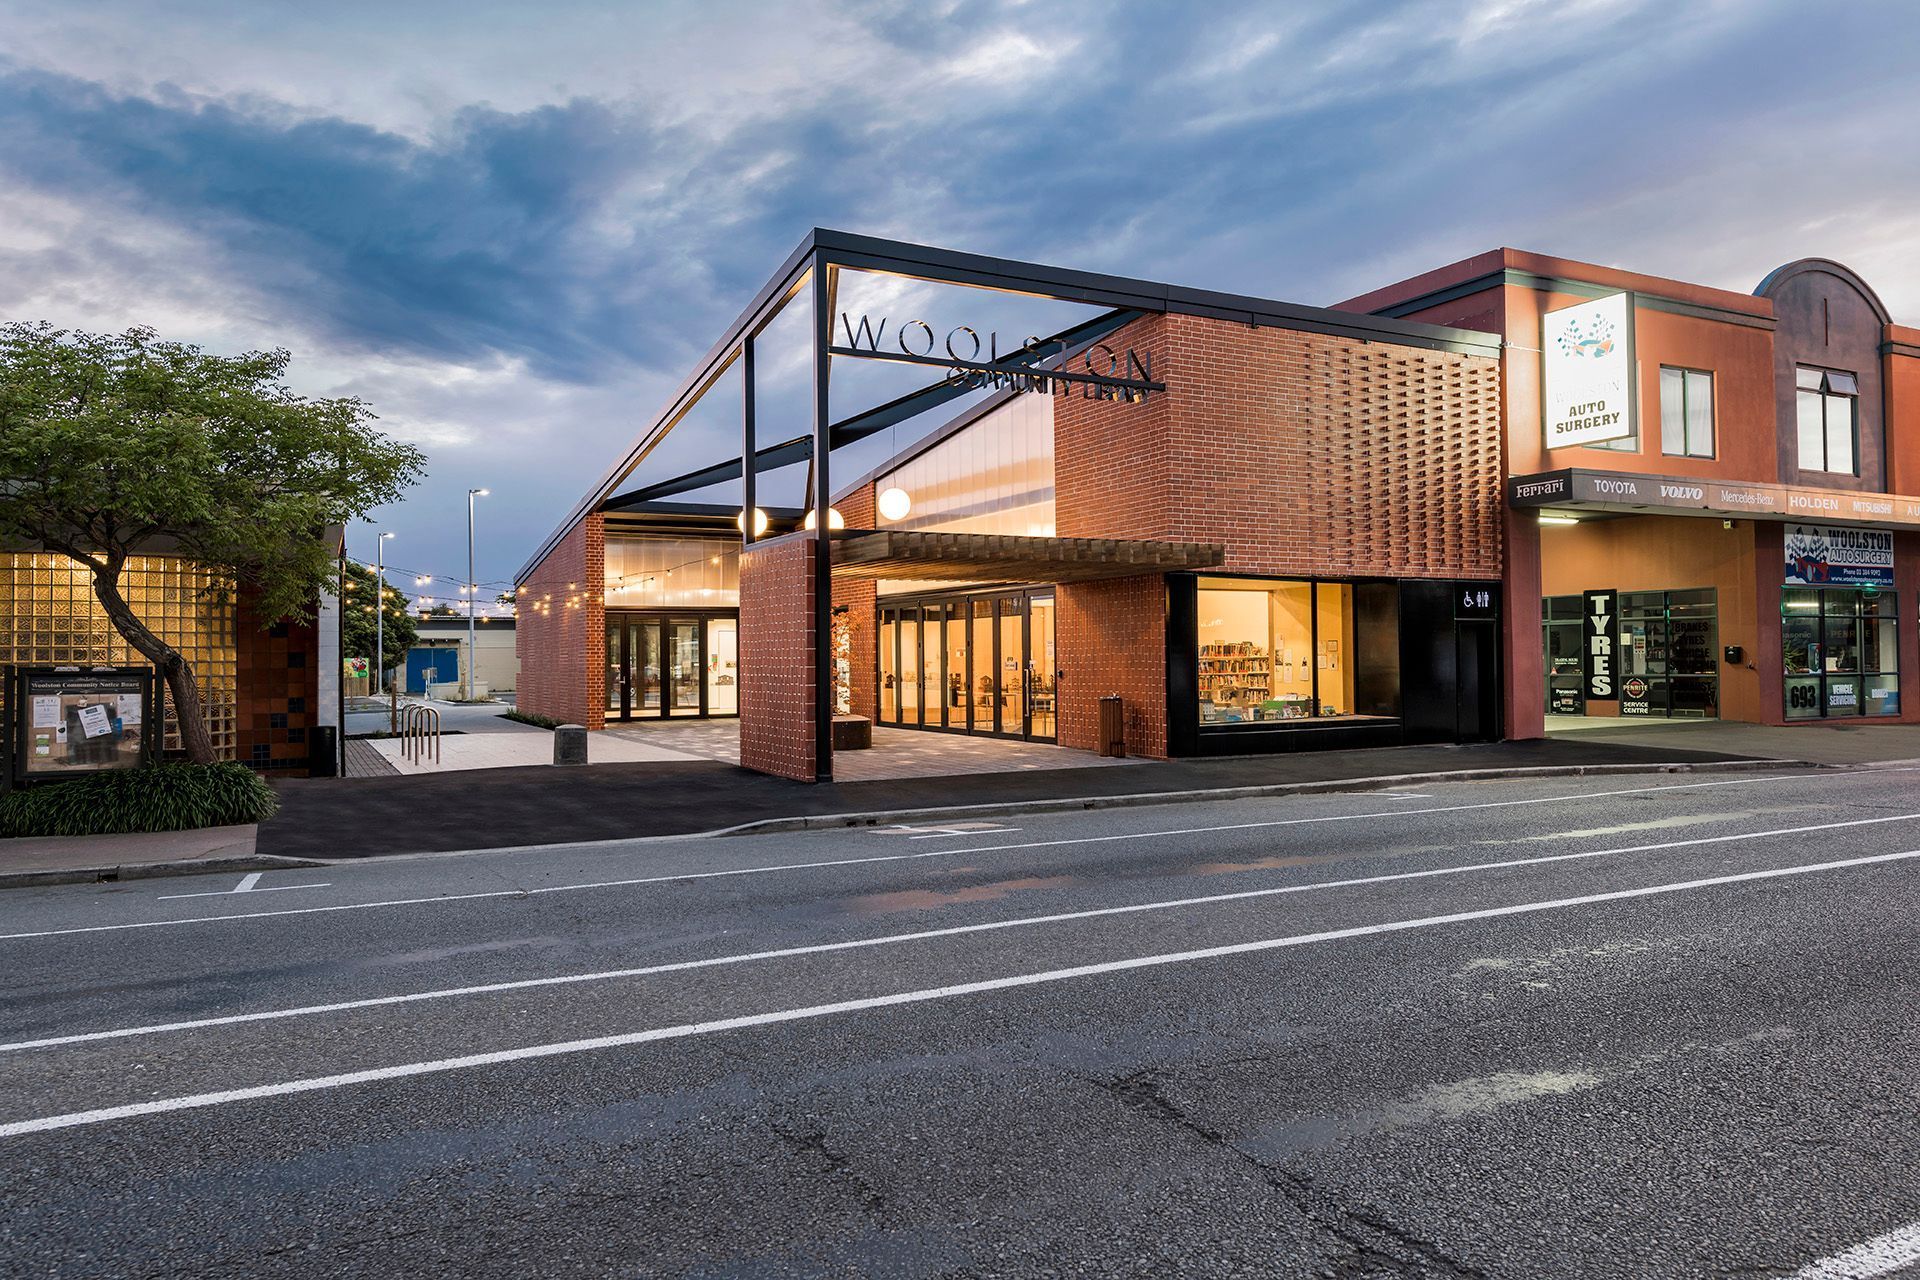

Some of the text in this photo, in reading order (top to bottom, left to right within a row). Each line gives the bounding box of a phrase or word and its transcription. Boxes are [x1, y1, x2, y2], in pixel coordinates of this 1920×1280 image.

[842, 312, 1151, 382] WOOLSTON
[1569, 400, 1606, 417] AUTO
[1556, 412, 1620, 434] SURGERY
[1516, 478, 1564, 498] Ferrari
[1594, 480, 1637, 495] TOYOTA
[1660, 485, 1704, 500] VOLVO
[1721, 490, 1775, 506] Mercedes-Benz
[1790, 496, 1839, 510] HOLDEN
[1853, 501, 1892, 514] MITSUBISHI
[1828, 530, 1891, 550] WOOLSTON
[1591, 595, 1612, 696] TYRES
[1791, 685, 1816, 708] 693
